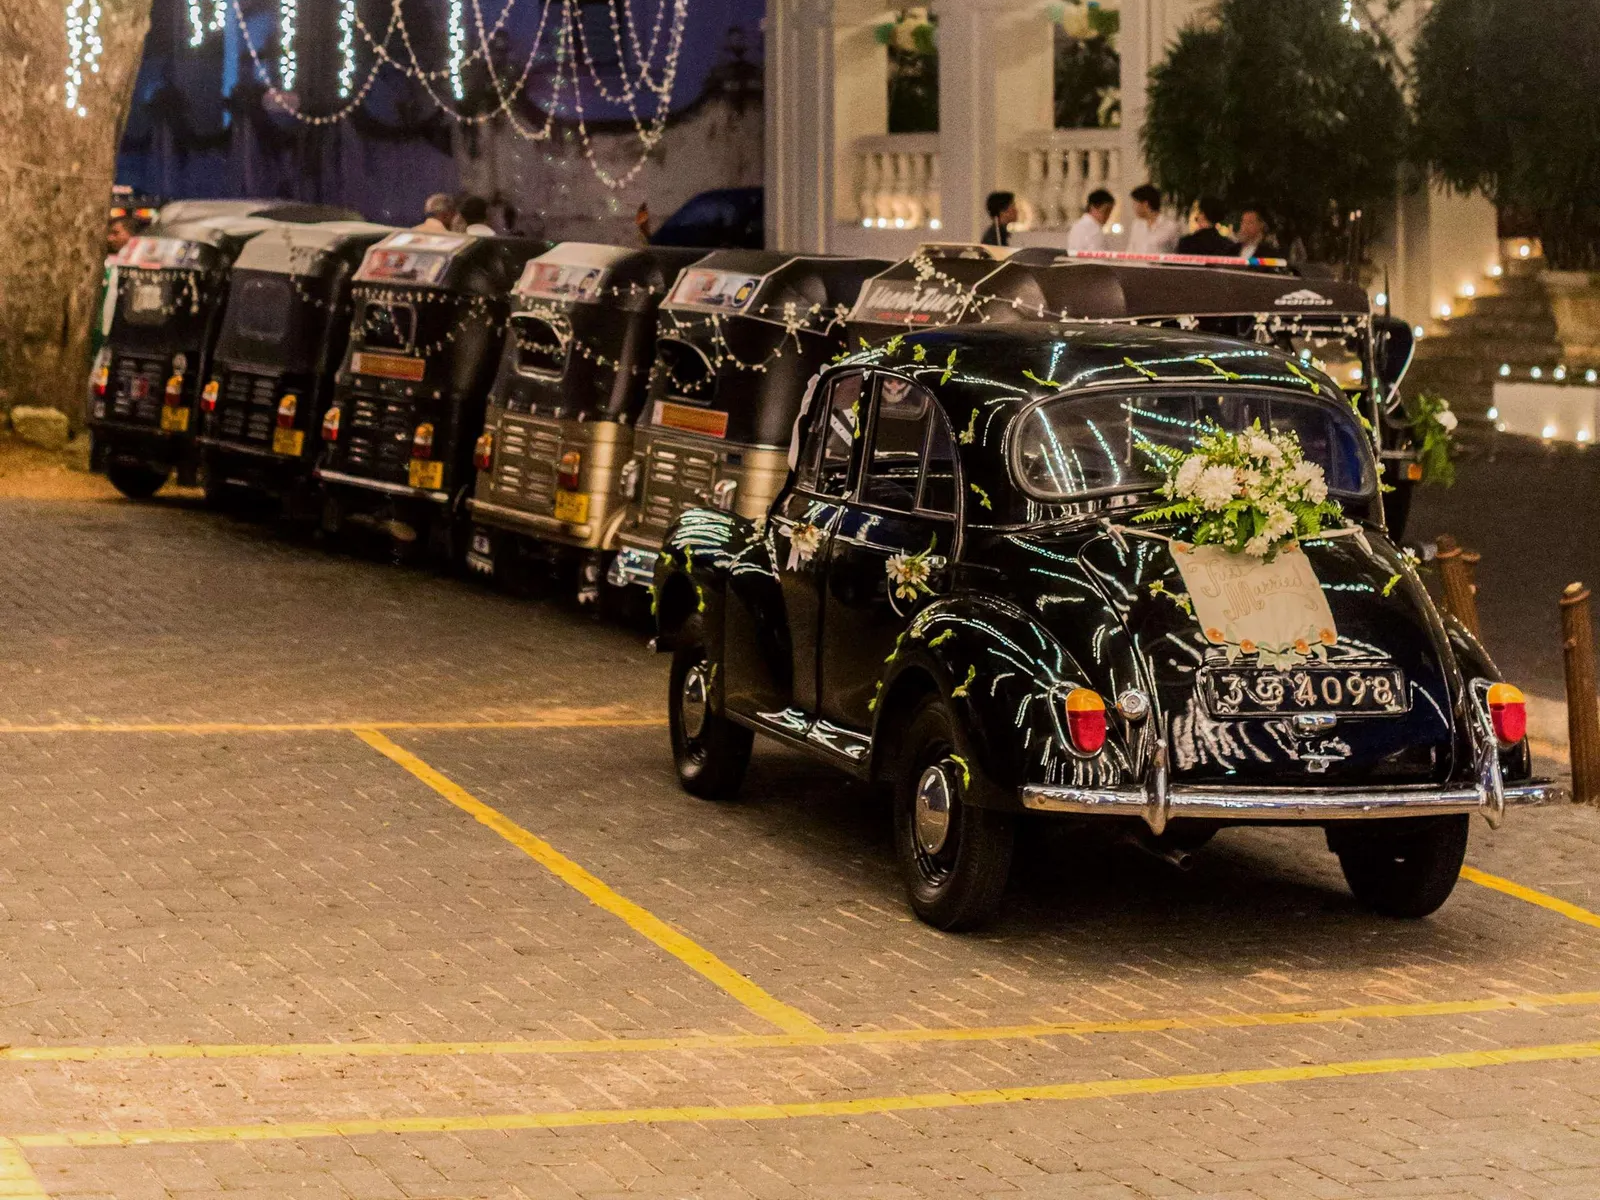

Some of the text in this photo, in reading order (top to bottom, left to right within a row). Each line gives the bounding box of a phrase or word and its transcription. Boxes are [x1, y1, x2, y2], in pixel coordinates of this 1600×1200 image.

[1188, 558, 1244, 598] Just
[1223, 562, 1305, 621] Married
[1297, 675, 1393, 706] 4098
